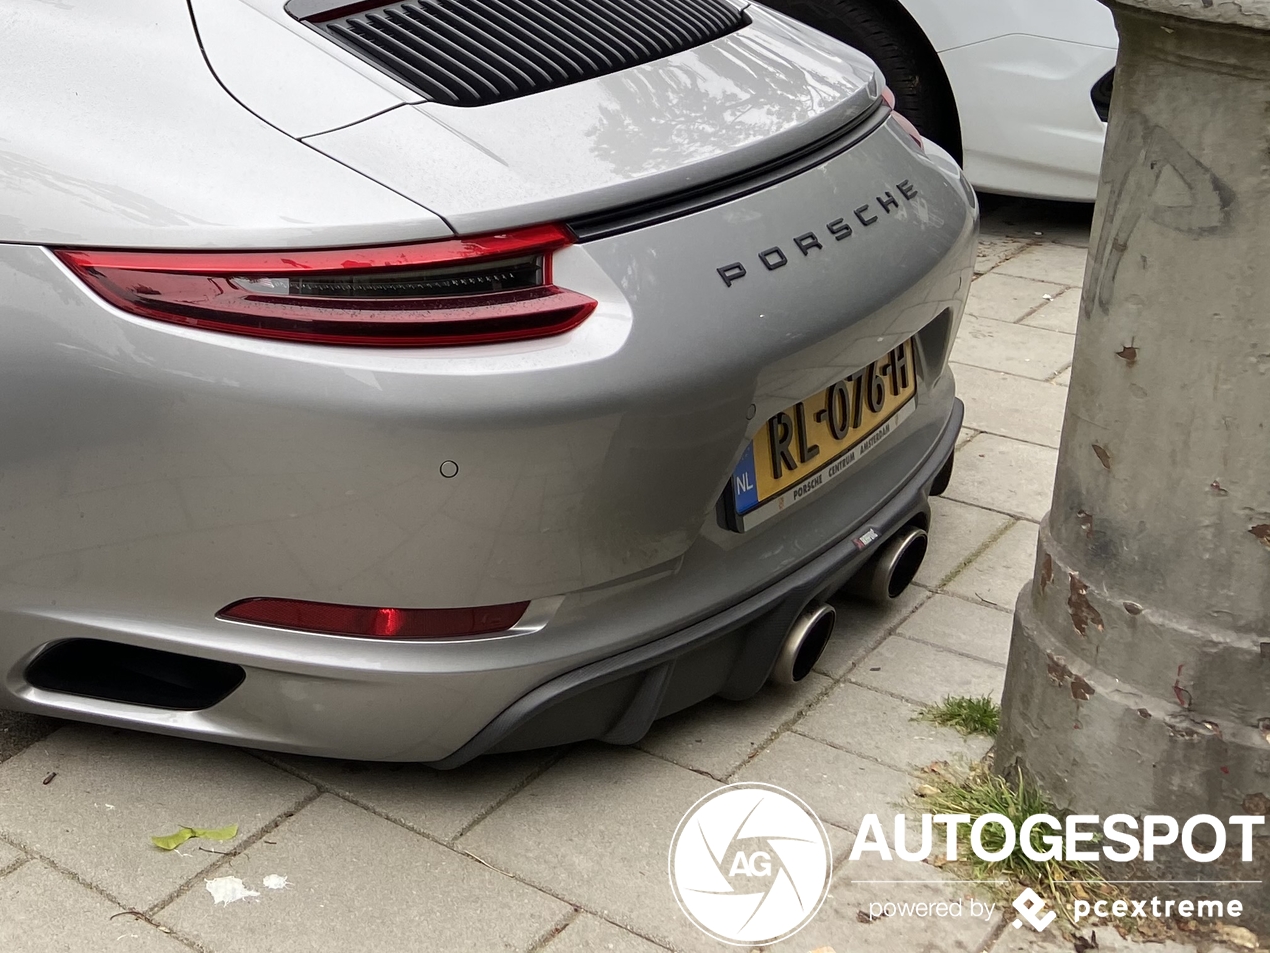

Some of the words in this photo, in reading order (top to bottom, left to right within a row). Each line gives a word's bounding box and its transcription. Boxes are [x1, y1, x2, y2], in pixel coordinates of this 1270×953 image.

[716, 179, 918, 287] PORSCHE
[736, 472, 754, 495] NL
[793, 474, 823, 500] PORSCHE
[828, 452, 856, 478] CENTRUM
[860, 424, 891, 456] AMSTERDAM
